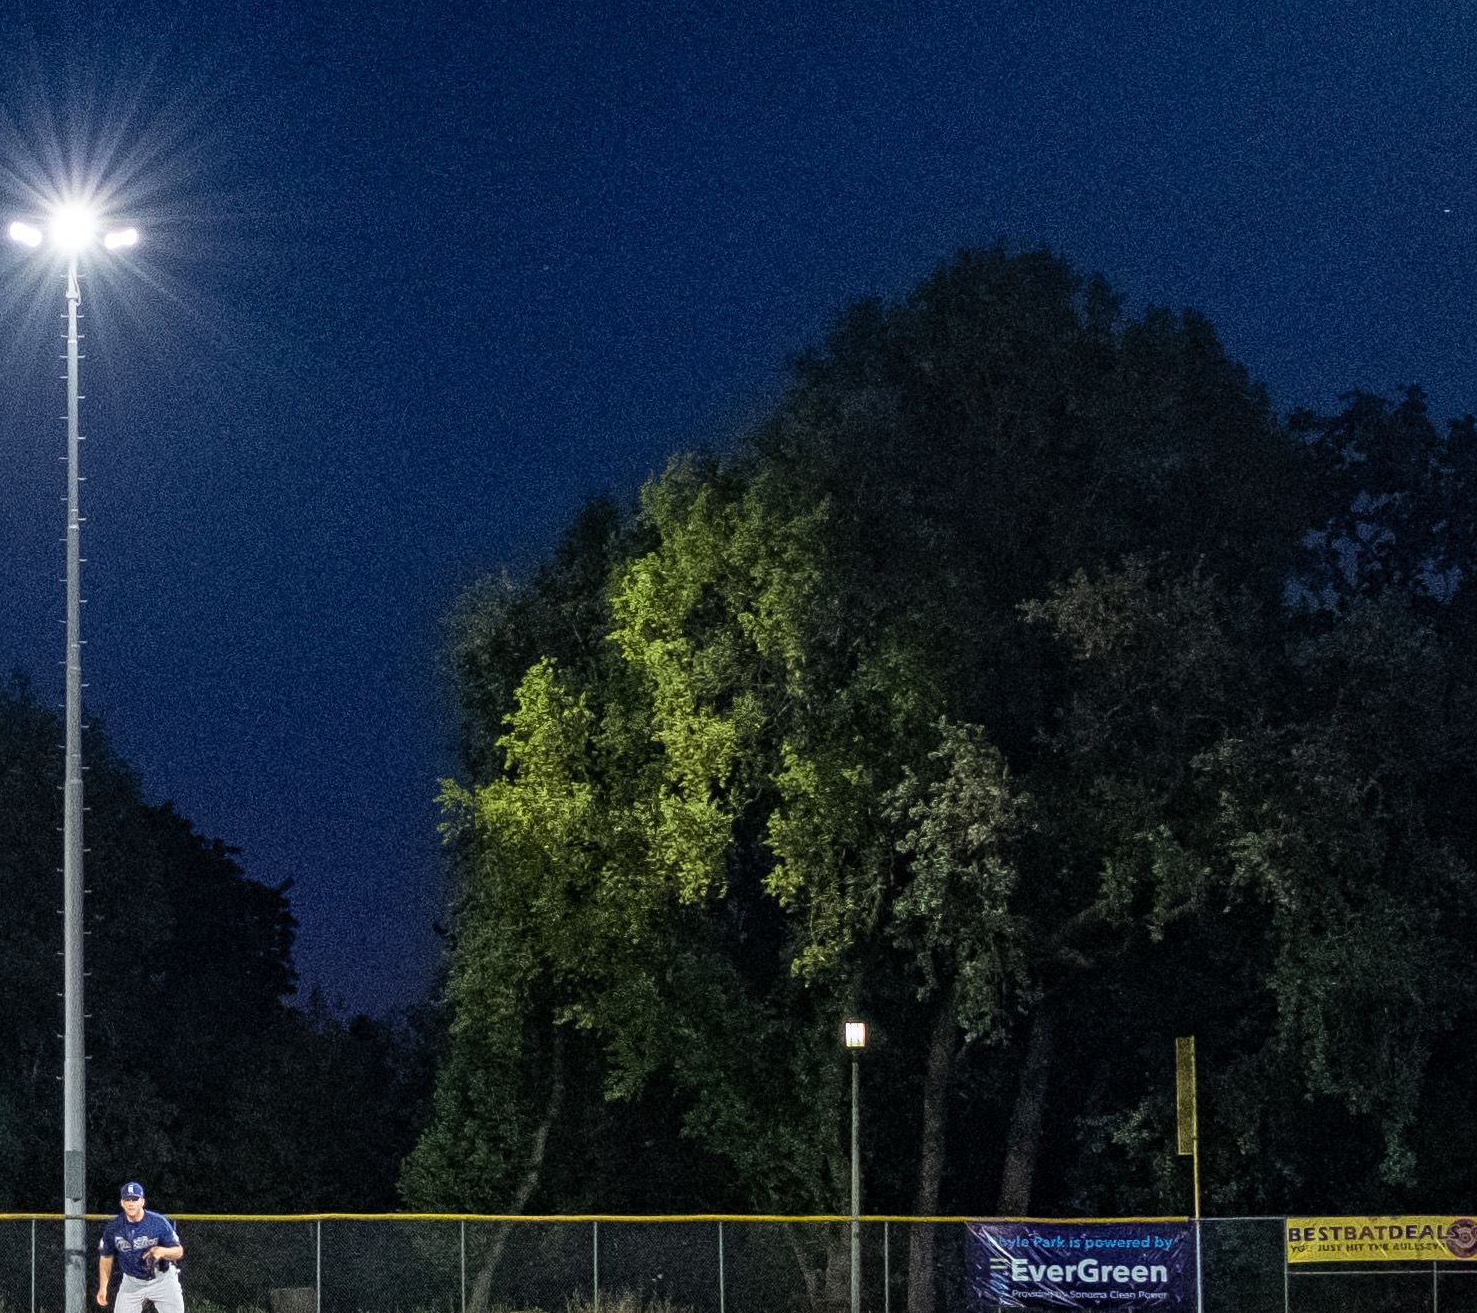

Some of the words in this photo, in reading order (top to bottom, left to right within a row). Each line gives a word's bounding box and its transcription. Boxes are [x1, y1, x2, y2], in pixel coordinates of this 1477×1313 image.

[1033, 1236, 1065, 1248] Park
[1069, 1236, 1081, 1248] is
[1085, 1236, 1150, 1251] powered
[1155, 1237, 1173, 1252] by
[1318, 1243, 1342, 1252] JUST
[1011, 1258, 1168, 1282] EverGreen
[1069, 1290, 1107, 1299] Sonoma
[1109, 1290, 1136, 1299] Clean
